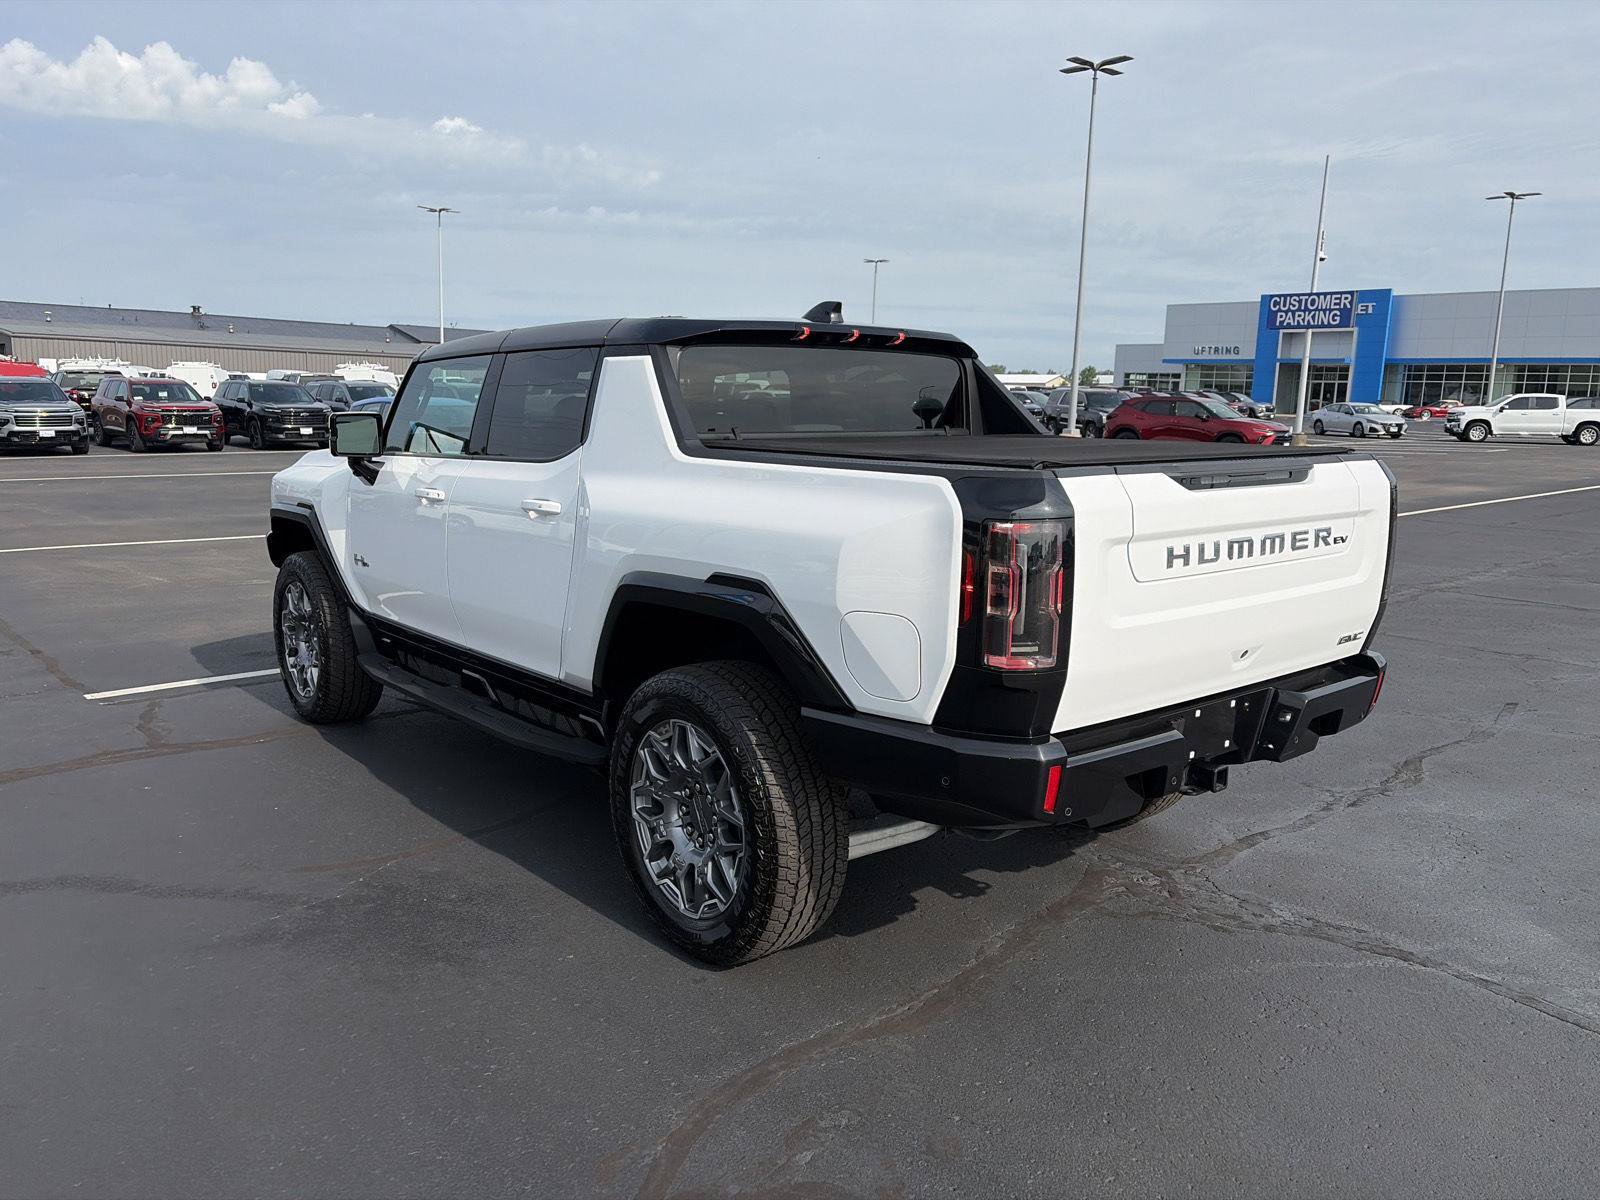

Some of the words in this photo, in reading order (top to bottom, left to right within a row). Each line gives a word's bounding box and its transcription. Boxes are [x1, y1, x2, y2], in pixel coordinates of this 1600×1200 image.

[1270, 294, 1352, 311] CUSTOMER
[1356, 303, 1376, 314] ET
[1276, 310, 1341, 326] PARKING
[1193, 346, 1240, 355] UFTRING
[1166, 526, 1332, 569] HUMMER
[1333, 535, 1349, 545] EV
